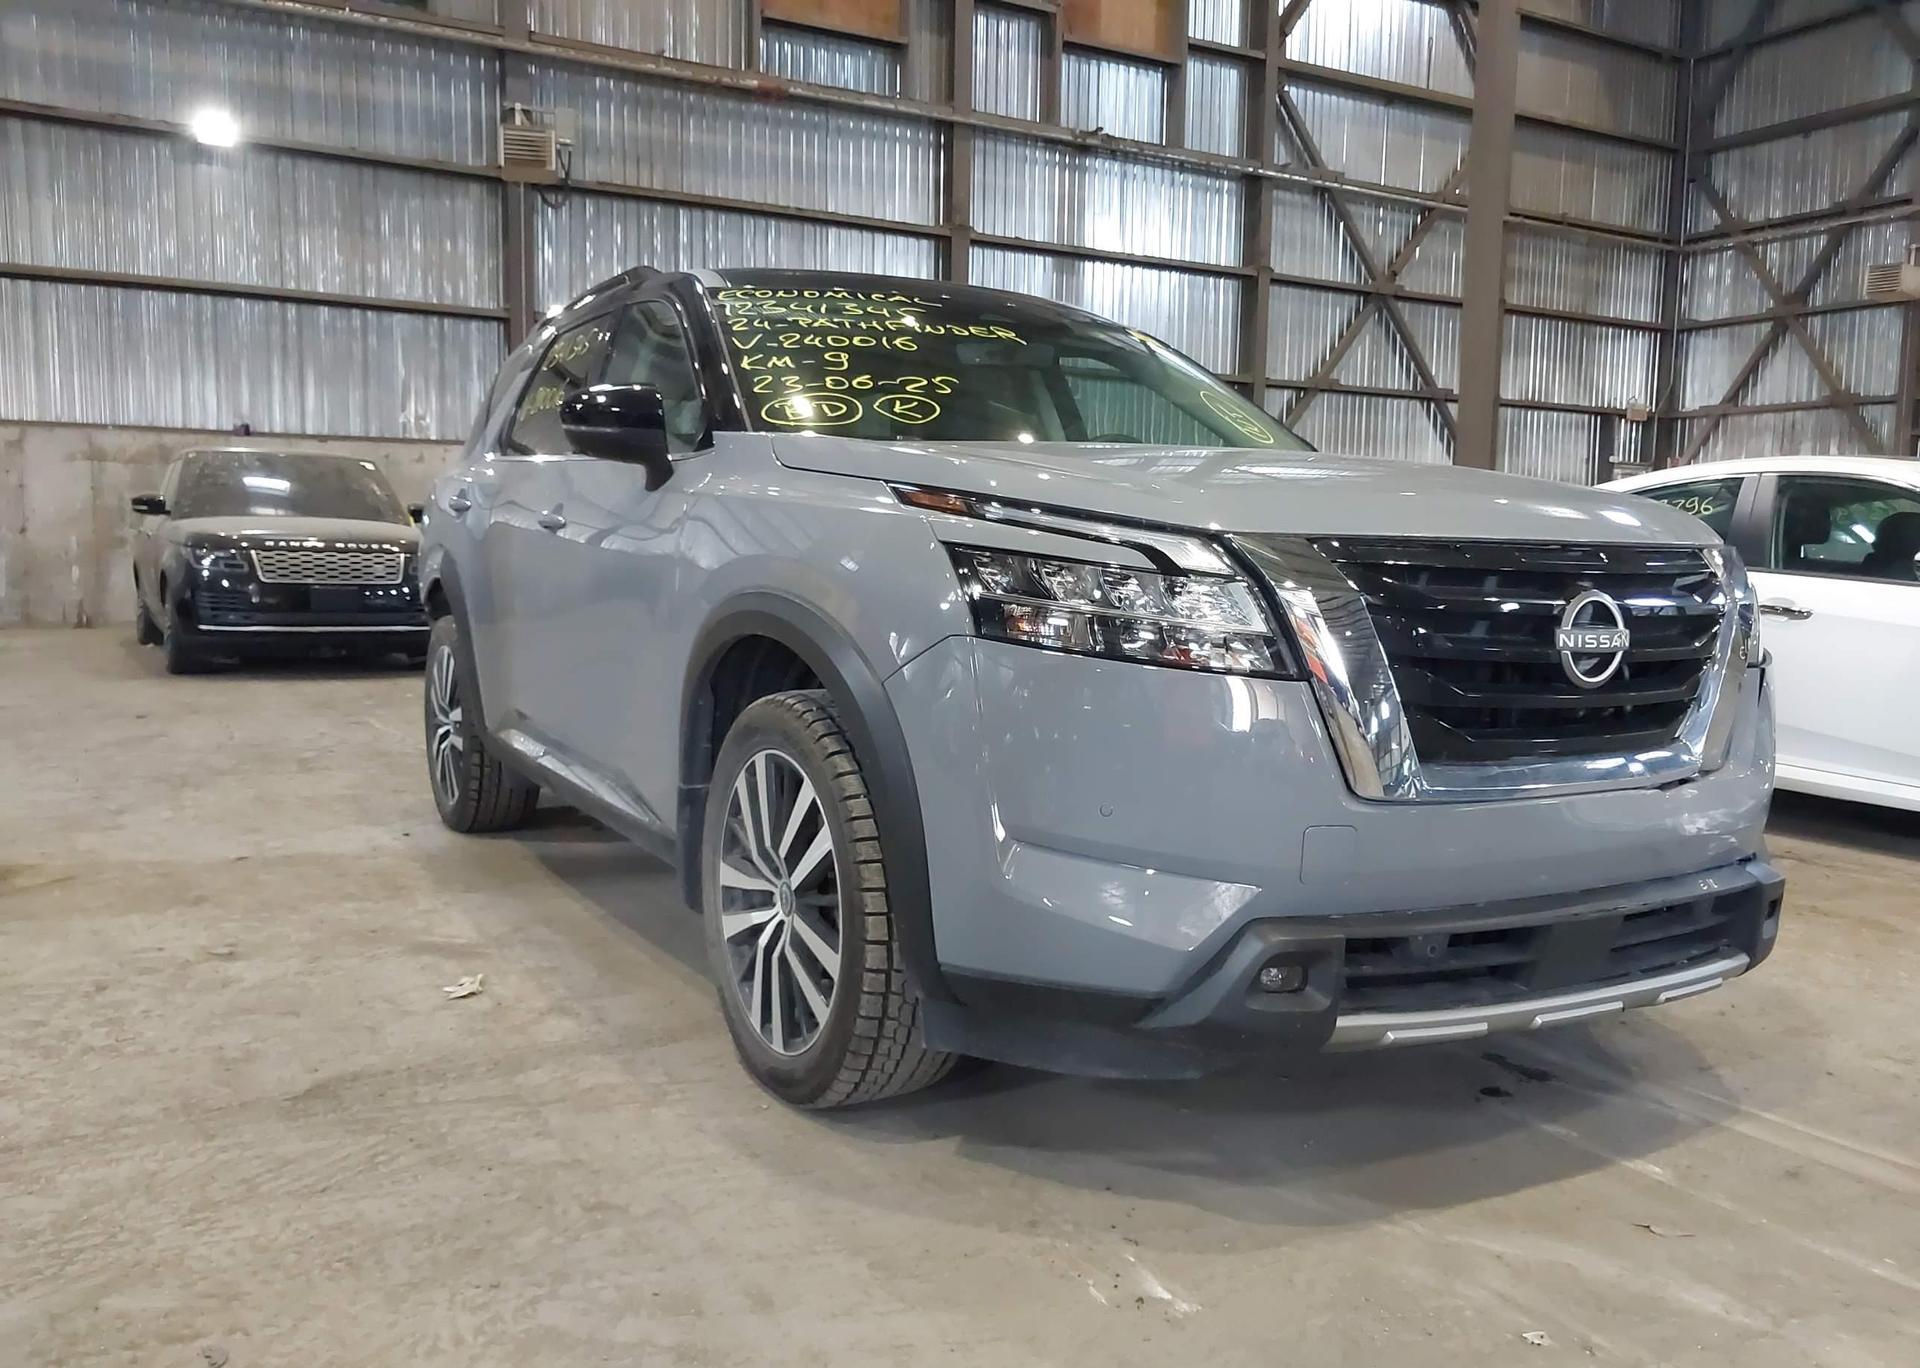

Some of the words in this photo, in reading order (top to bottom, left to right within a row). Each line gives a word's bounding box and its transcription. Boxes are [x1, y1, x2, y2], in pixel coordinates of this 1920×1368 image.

[718, 289, 943, 308] ECONOMICAL
[753, 375, 959, 394] 23-06-25
[1558, 633, 1630, 649] NISSAN
